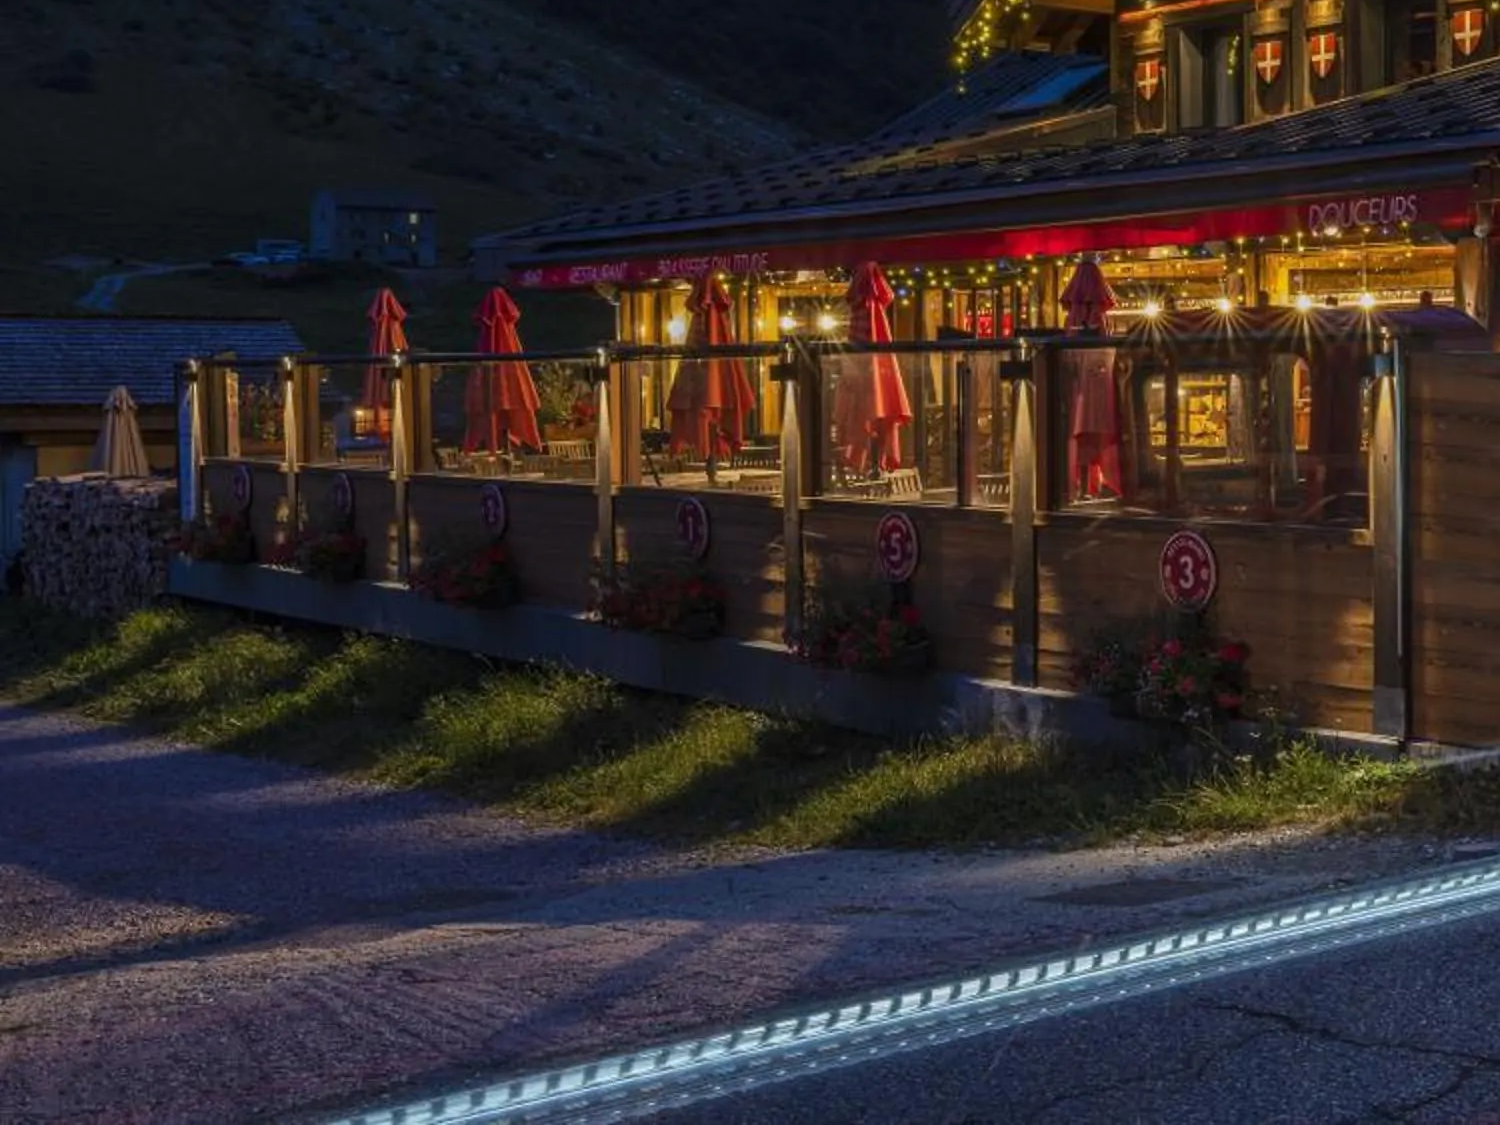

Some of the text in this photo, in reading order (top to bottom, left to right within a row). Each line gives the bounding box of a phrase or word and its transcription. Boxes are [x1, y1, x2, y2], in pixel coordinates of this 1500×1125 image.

[1308, 194, 1418, 232] DOUCEURS
[889, 531, 902, 563] 5
[1179, 555, 1196, 590] 3
